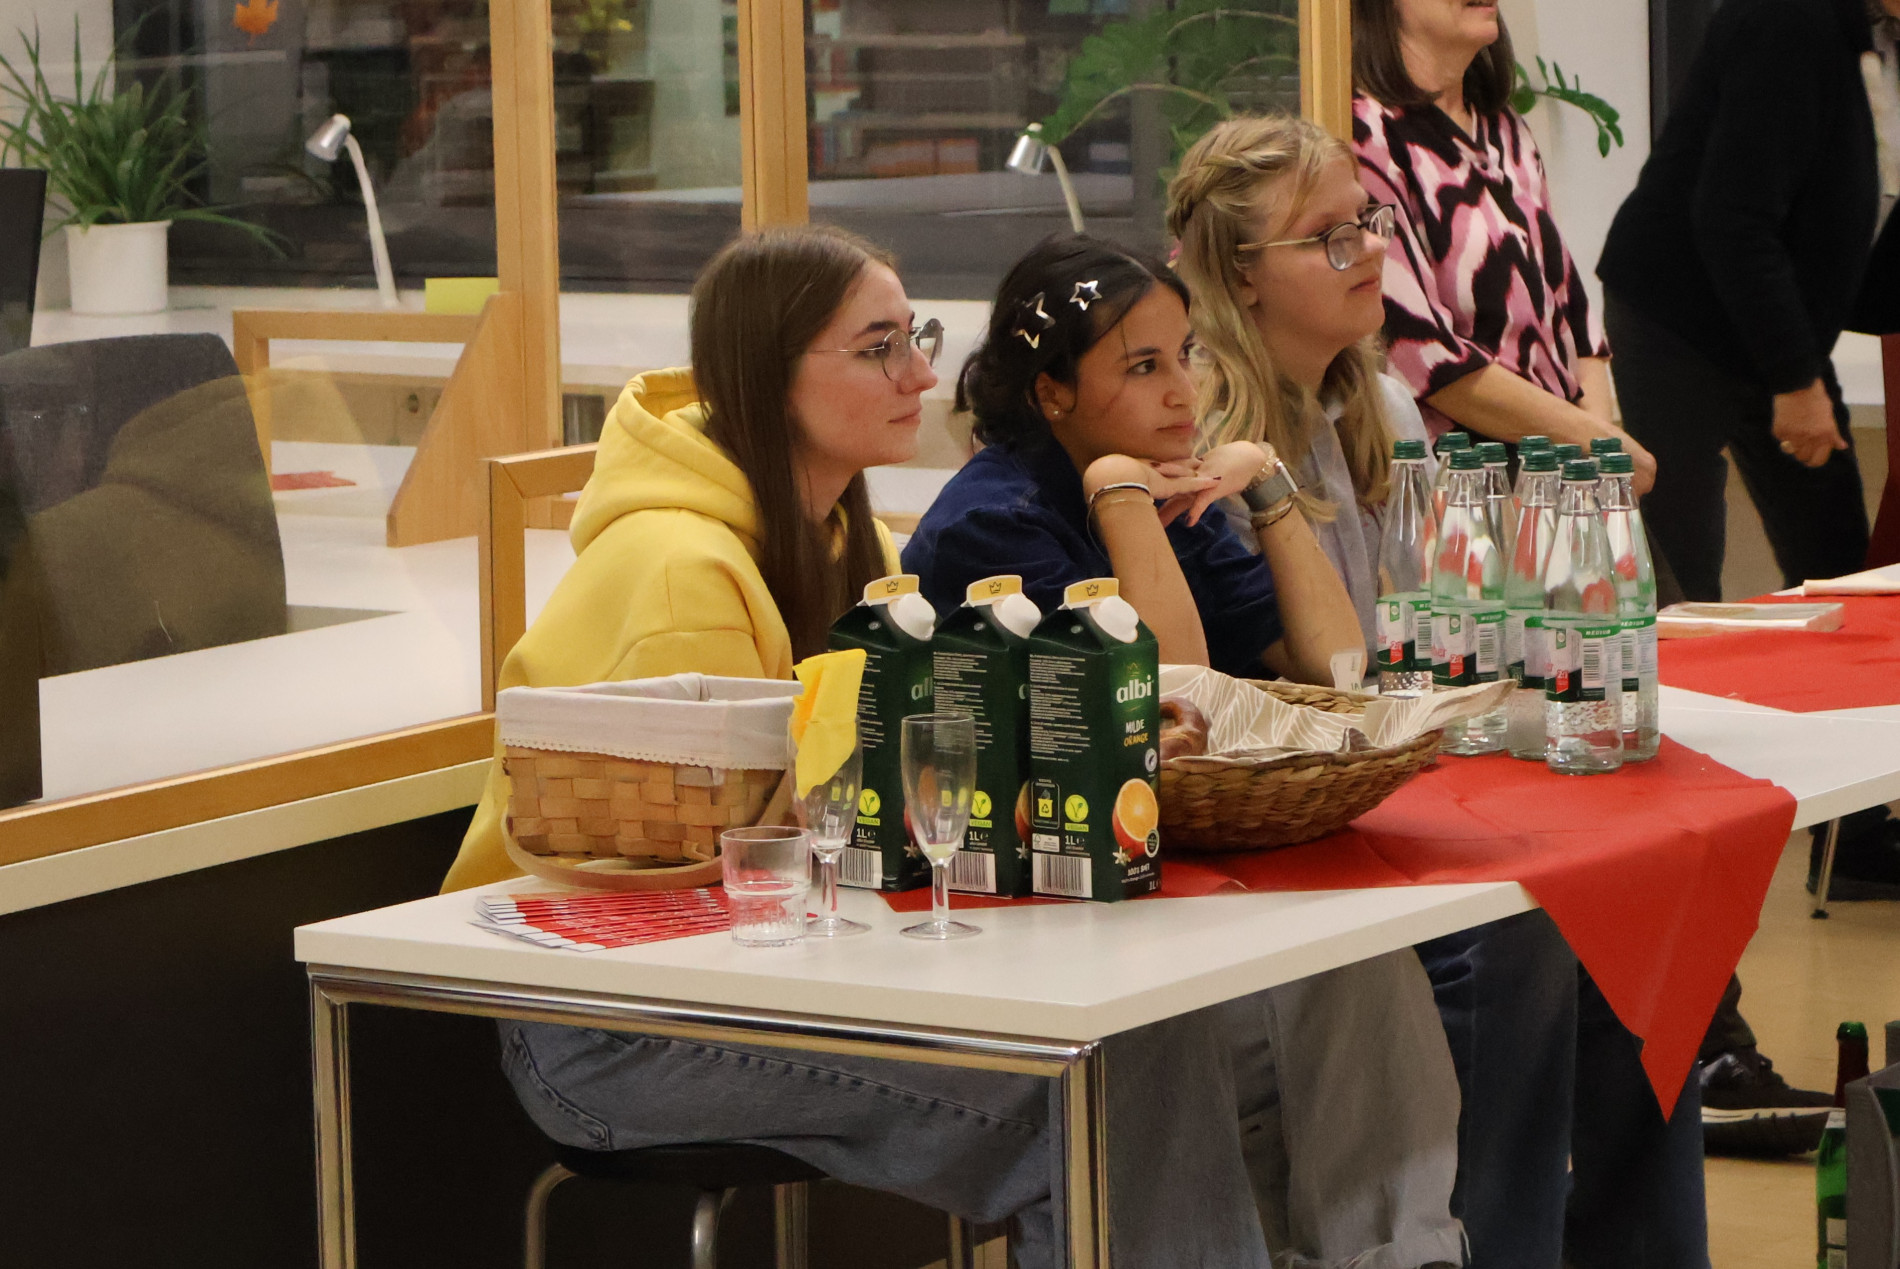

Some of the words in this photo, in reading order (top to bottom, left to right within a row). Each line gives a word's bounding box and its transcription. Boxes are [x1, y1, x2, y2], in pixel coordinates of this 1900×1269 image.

[1116, 674, 1152, 704] albi
[1125, 719, 1145, 734] MILDE
[1123, 733, 1149, 747] ORANGE
[858, 816, 880, 826] VEGAN
[970, 820, 993, 828] VEGAN
